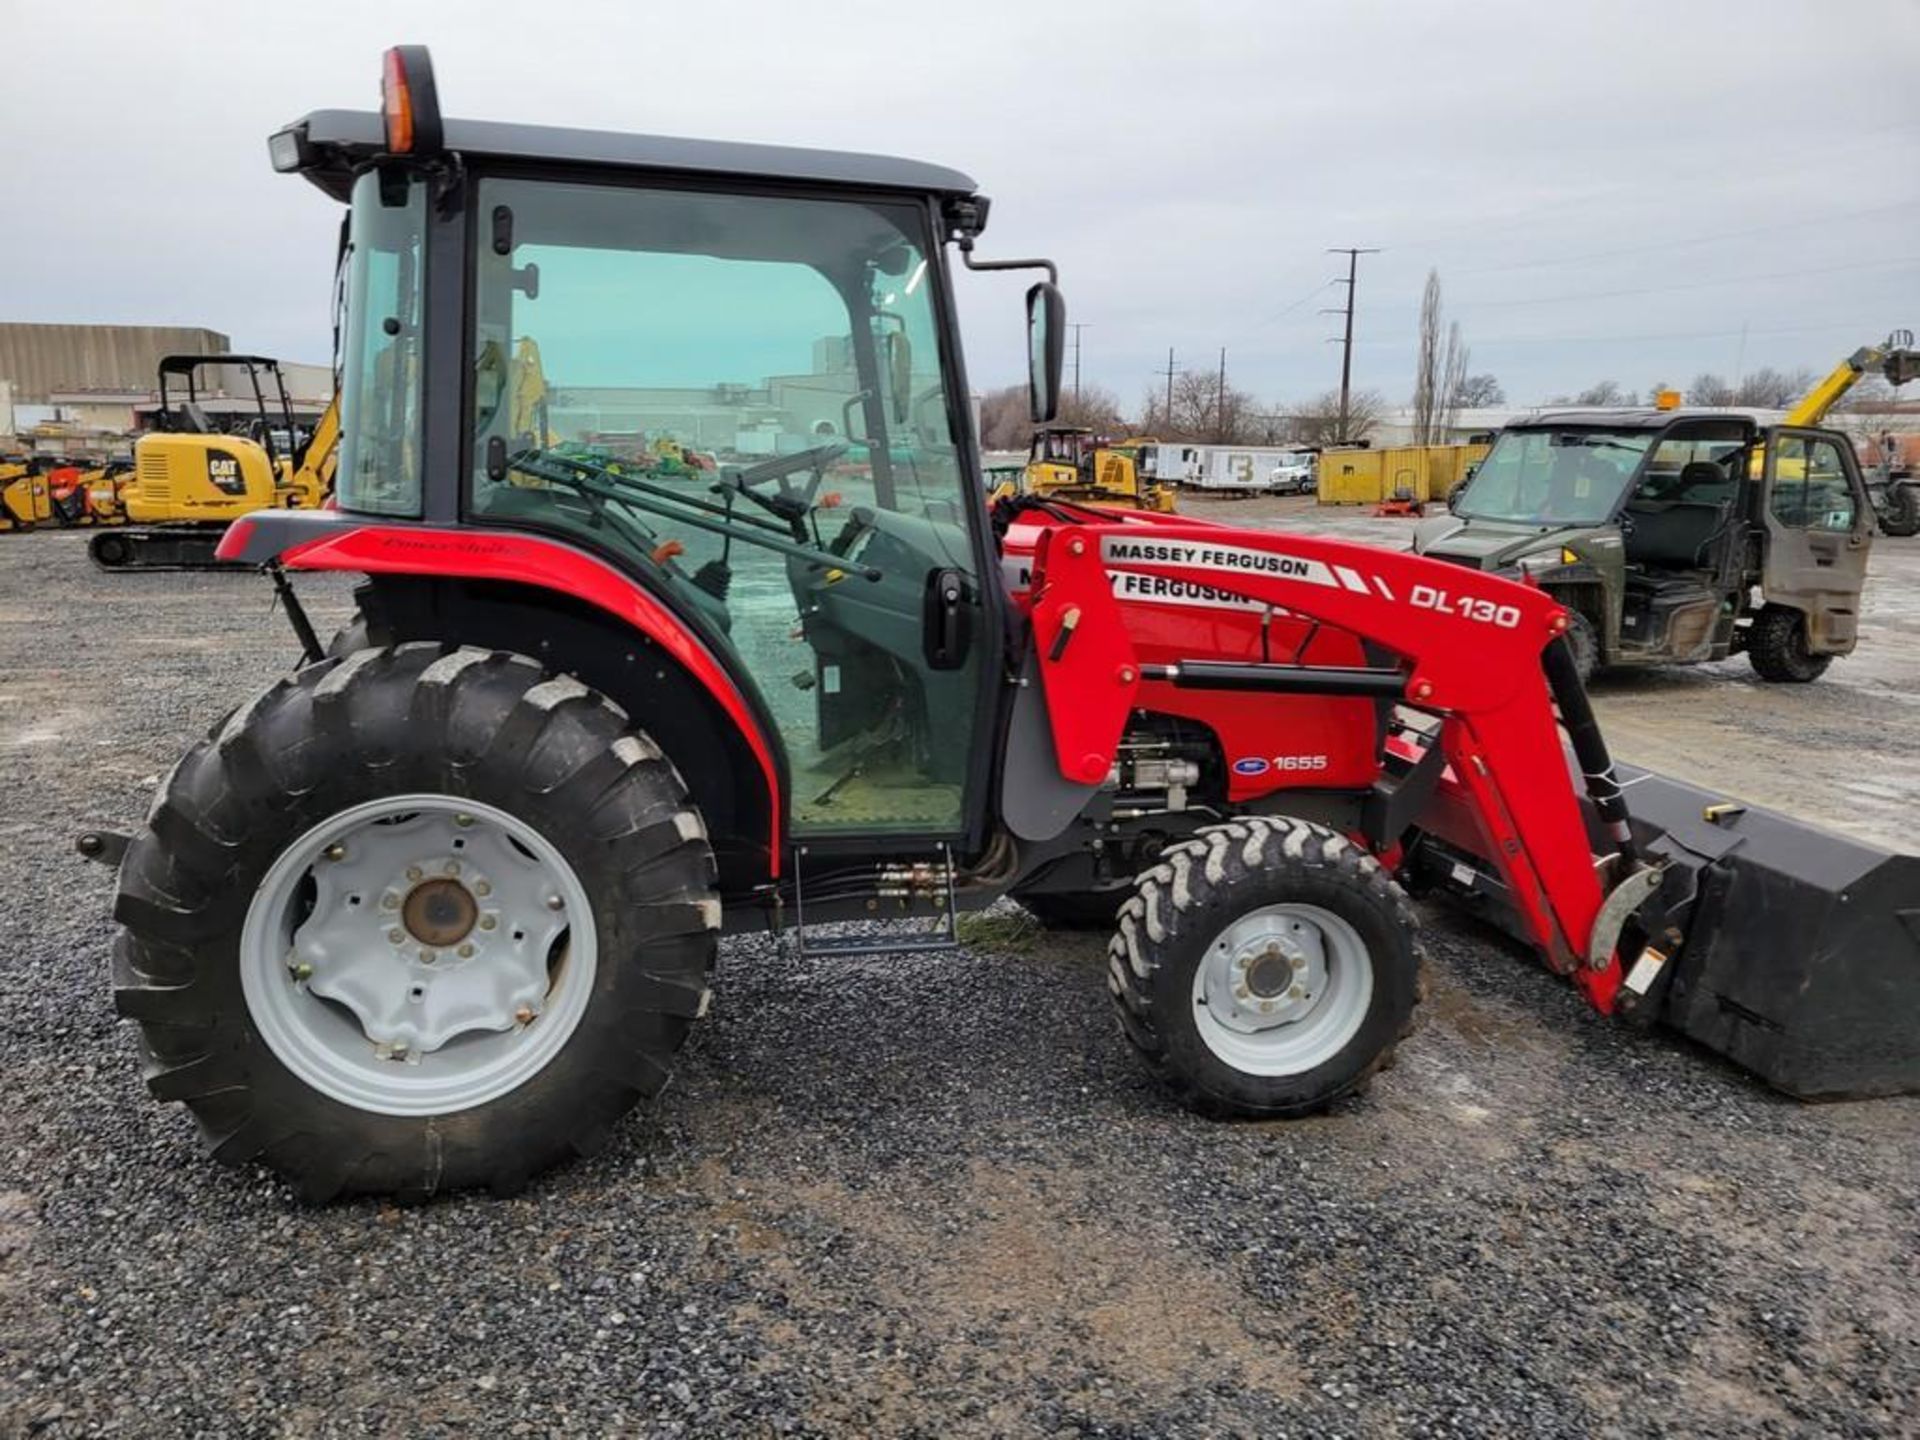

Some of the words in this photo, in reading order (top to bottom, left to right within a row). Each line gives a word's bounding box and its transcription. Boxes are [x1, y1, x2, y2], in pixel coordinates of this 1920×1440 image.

[210, 460, 236, 475] CAT
[1109, 544, 1196, 562] MASSEY
[1201, 550, 1309, 577] FERGUSON
[1409, 584, 1521, 629] DL130
[1272, 754, 1327, 771] 1655
